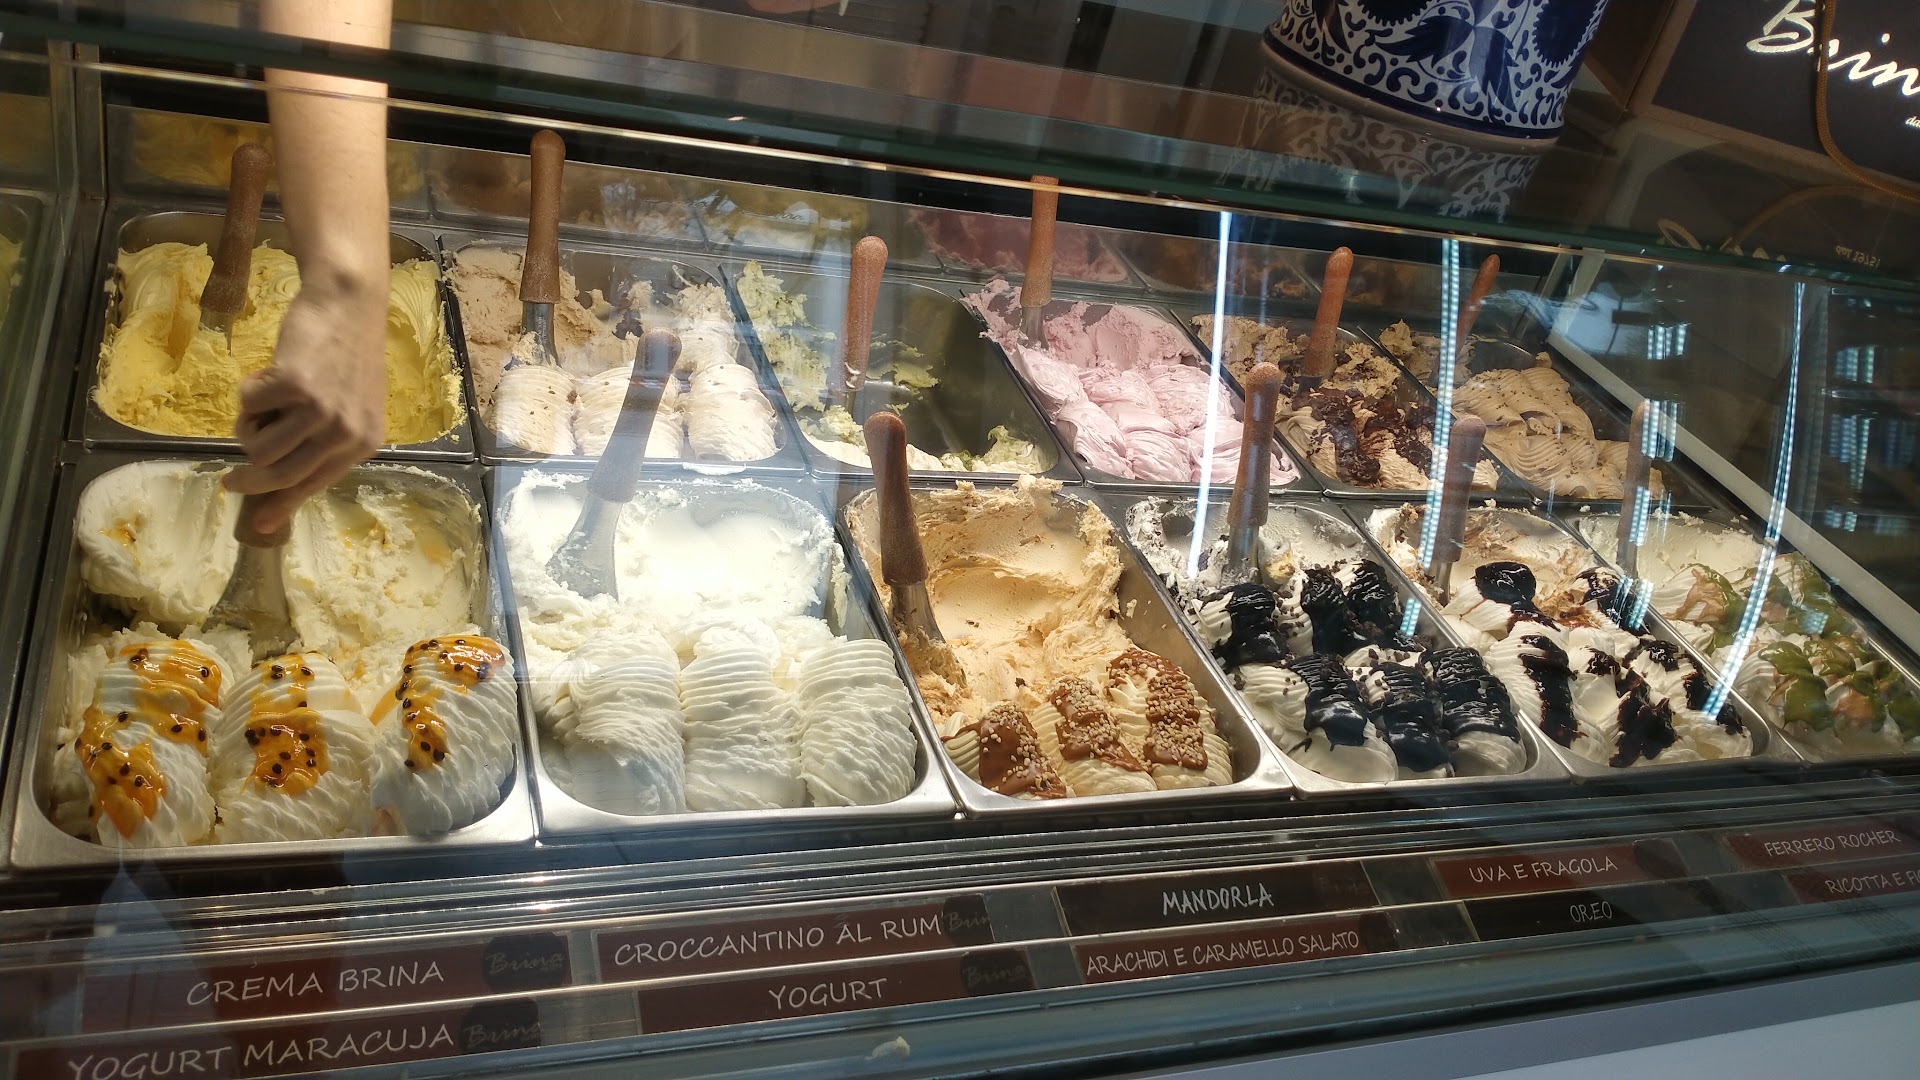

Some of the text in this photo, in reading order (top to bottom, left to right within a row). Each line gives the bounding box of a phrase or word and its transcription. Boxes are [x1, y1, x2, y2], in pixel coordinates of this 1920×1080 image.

[1764, 830, 1902, 857] FERRERO ROCHER
[1468, 856, 1619, 883] UVA E FRAGOLA
[1824, 874, 1894, 894] RICOTTA
[1892, 872, 1906, 887] E
[1161, 881, 1275, 916] MANDORLA
[1569, 901, 1613, 923] OREO
[614, 914, 942, 967] CROCCANTINO AL RUM
[1085, 930, 1360, 977] ARACHIDI E CARAMELLO SALATO
[186, 960, 446, 1007] CREMA BRINA
[768, 977, 888, 1012] YOGURT
[68, 1024, 455, 1080] YOGURT MARACUJA
